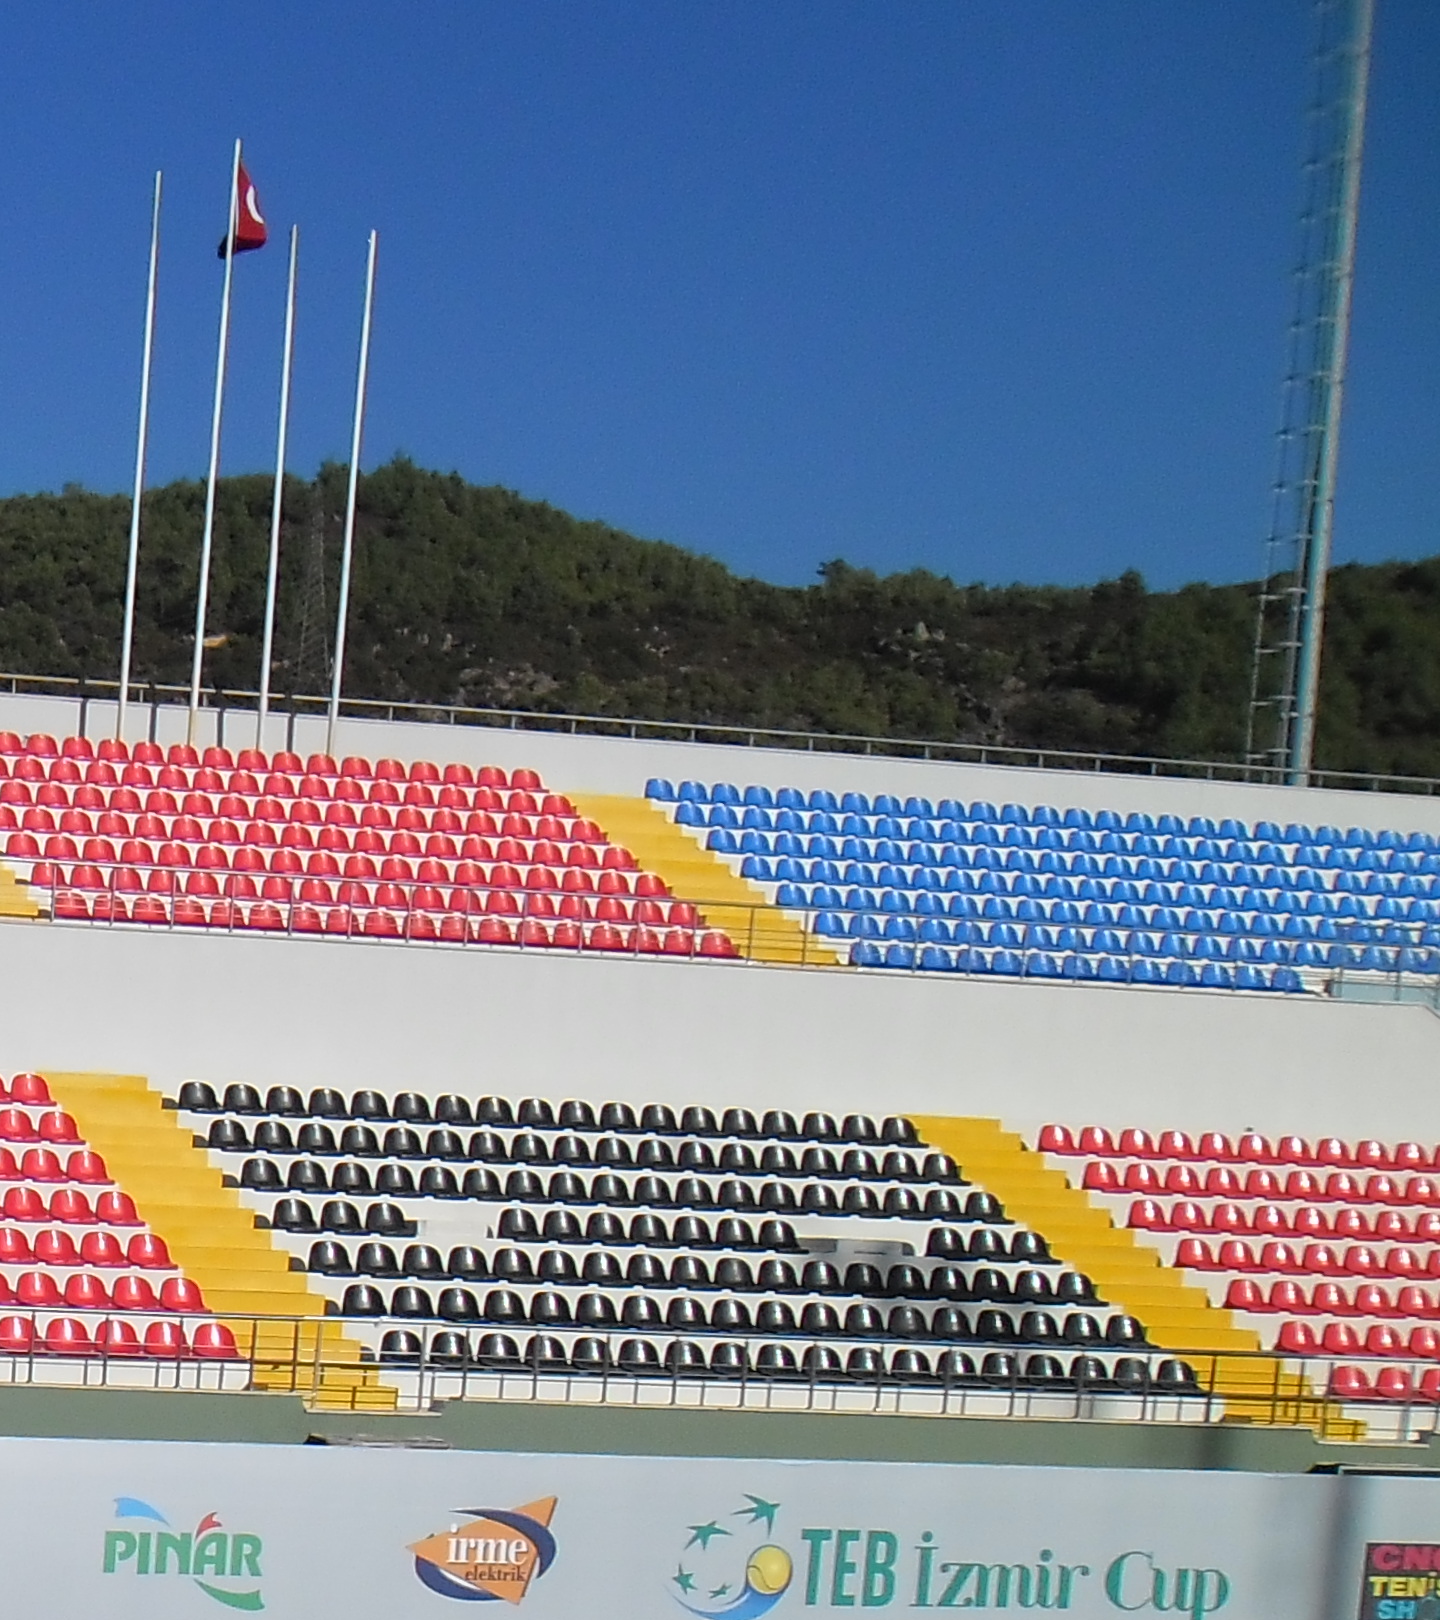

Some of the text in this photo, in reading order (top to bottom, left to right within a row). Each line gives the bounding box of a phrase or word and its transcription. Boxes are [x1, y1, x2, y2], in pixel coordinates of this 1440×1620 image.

[102, 1530, 263, 1577] PINAR
[446, 1523, 528, 1565] irme
[1373, 1545, 1440, 1571] CN
[465, 1565, 526, 1582] elektrik
[801, 1528, 898, 1608] TEB
[909, 1530, 1090, 1609] İzmir
